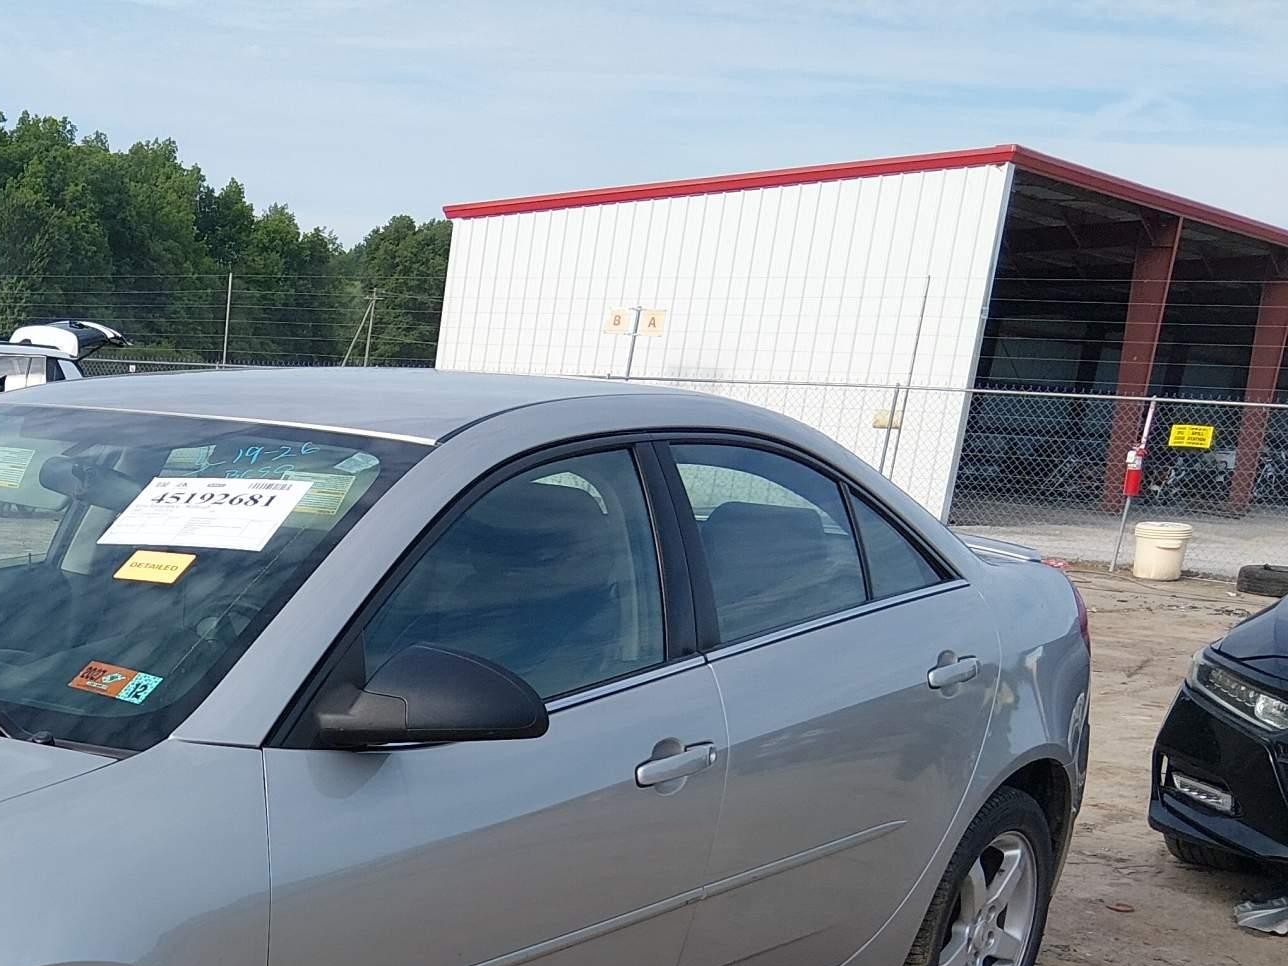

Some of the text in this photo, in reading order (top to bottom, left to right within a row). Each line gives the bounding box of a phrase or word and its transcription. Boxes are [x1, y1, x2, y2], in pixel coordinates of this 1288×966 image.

[613, 315, 621, 326] B
[648, 316, 656, 328] A
[151, 491, 276, 507] 45192681
[129, 562, 178, 572] DETAILED
[128, 683, 148, 699] 12
